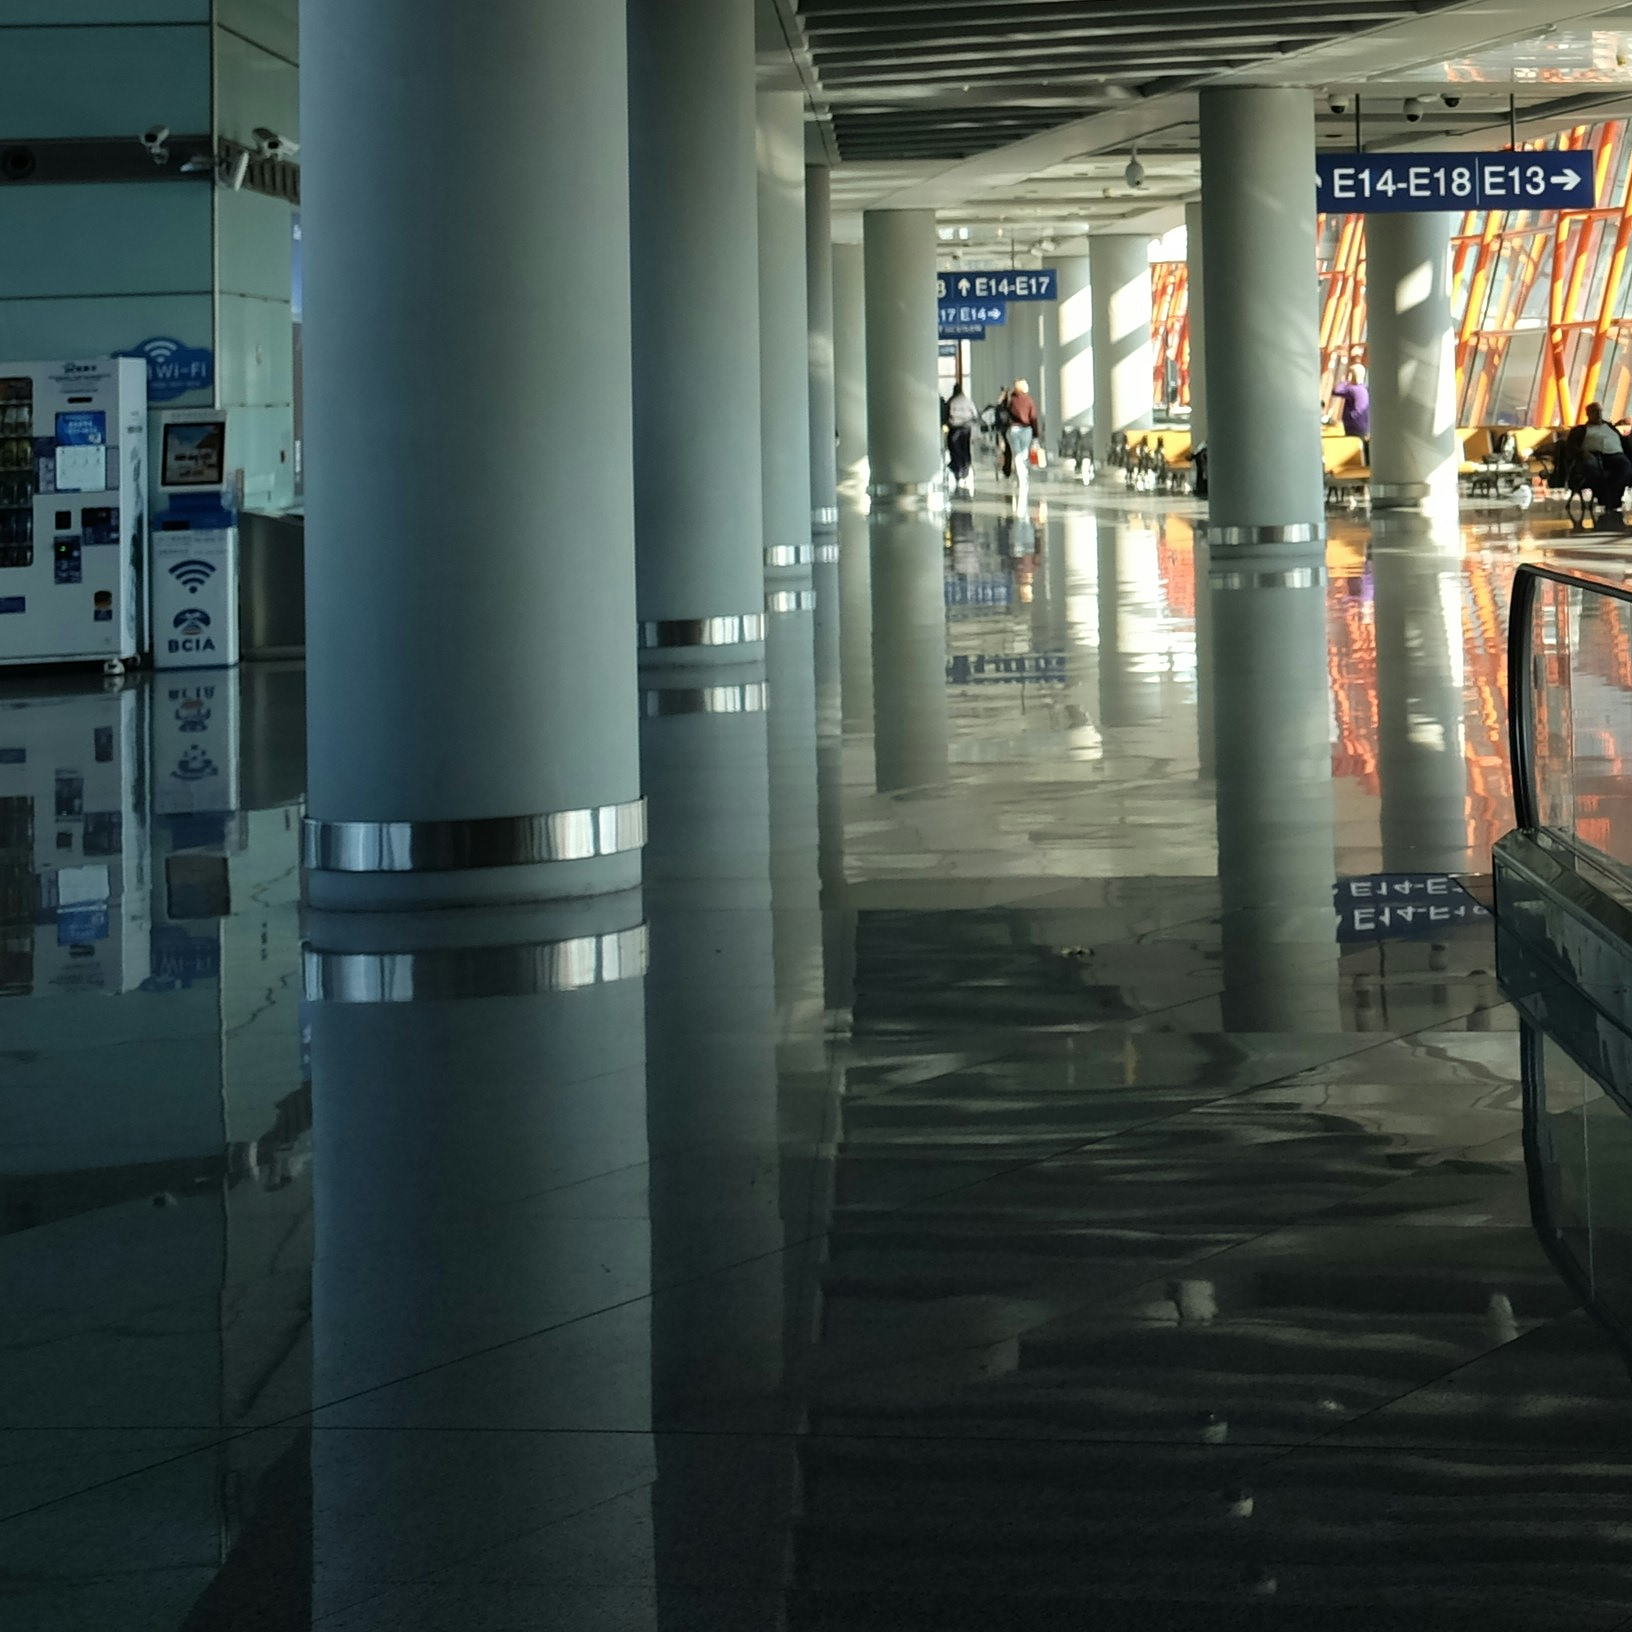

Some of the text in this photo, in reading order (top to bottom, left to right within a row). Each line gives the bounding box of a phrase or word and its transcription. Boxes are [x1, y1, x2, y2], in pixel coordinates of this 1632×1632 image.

[1333, 166, 1472, 198] E14-E18
[1484, 165, 1546, 196] E13
[975, 276, 1050, 297] E14-E17
[168, 638, 215, 654] BCIA
